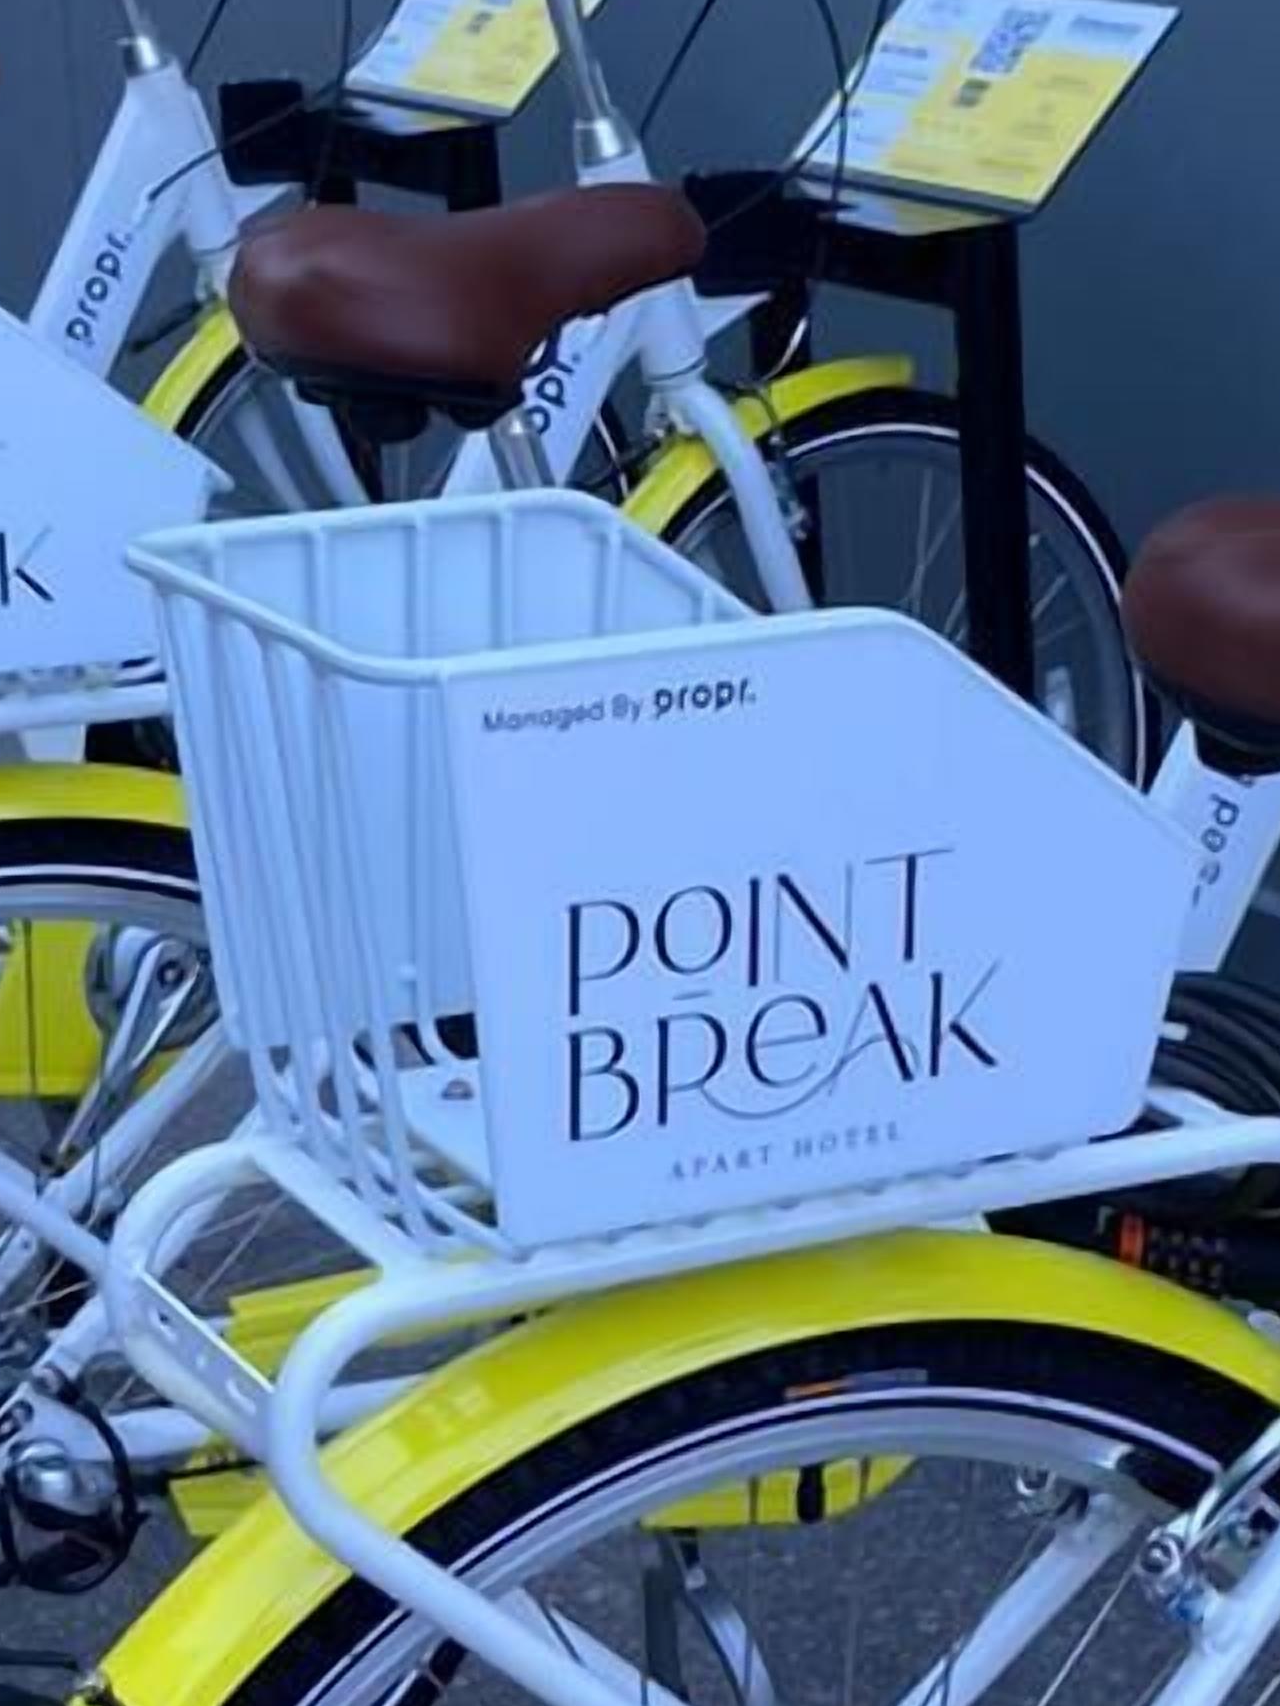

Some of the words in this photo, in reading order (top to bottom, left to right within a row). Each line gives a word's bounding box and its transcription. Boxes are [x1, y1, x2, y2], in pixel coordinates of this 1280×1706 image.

[482, 695, 605, 734] Managed
[611, 695, 643, 724] By
[566, 846, 958, 1018] POINT
[566, 956, 1004, 1143] BREAK
[666, 1143, 775, 1181] APART
[792, 1121, 905, 1161] HOTEL
